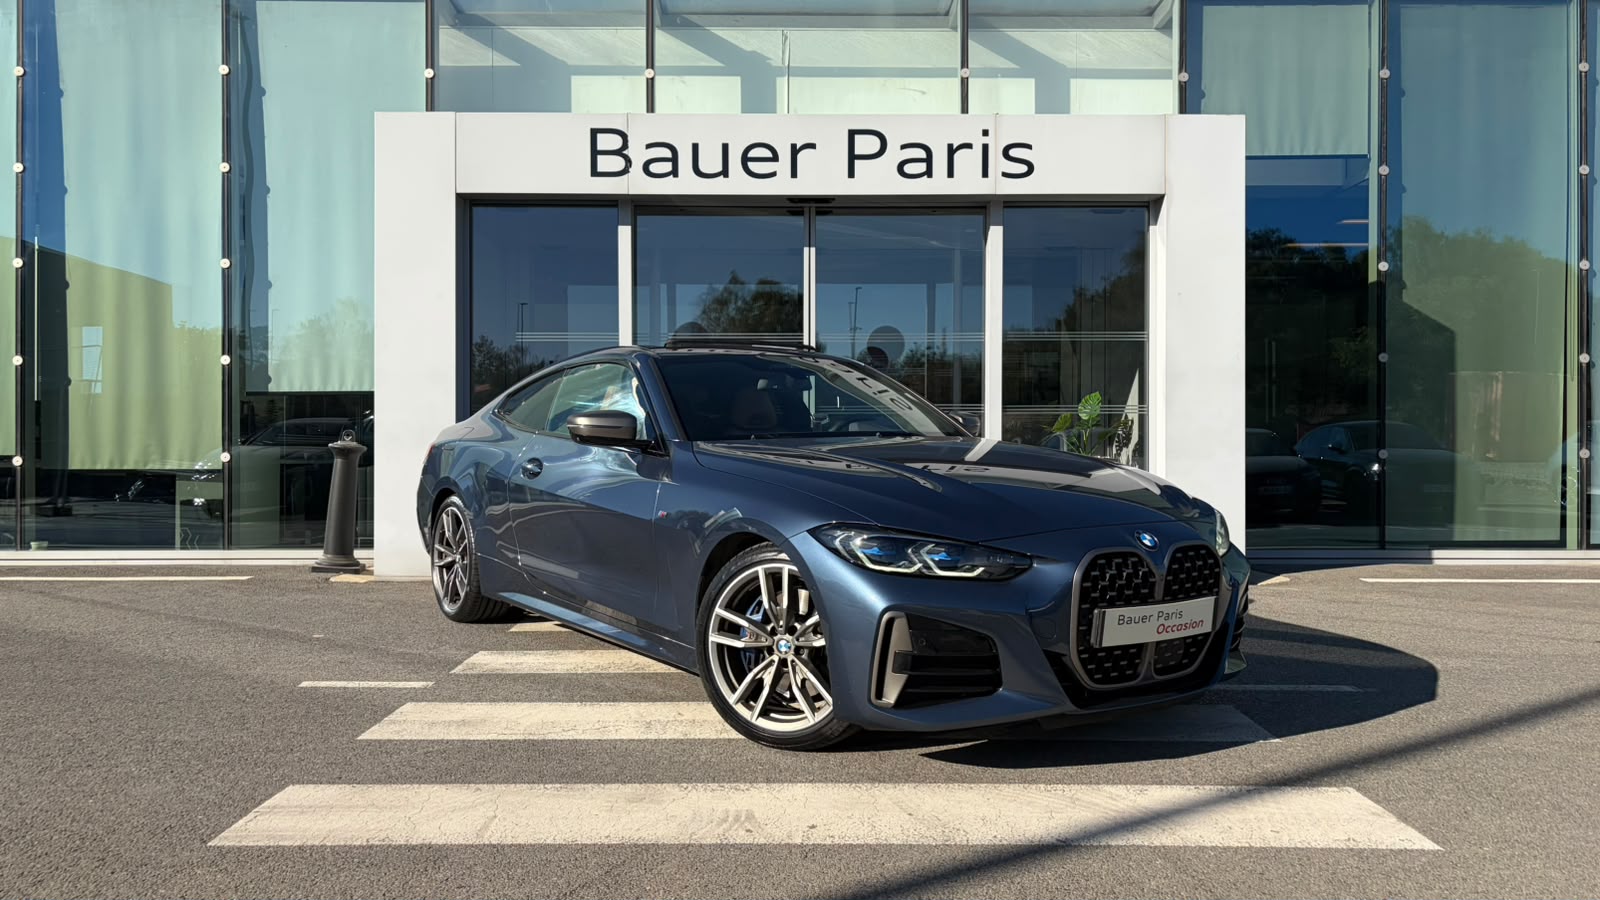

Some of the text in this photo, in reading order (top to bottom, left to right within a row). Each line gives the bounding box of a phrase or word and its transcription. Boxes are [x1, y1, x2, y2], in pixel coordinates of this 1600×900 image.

[590, 127, 1035, 179] Bauer Paris
[1117, 609, 1184, 626] Bauer Paris
[1156, 618, 1204, 635] Occasion
